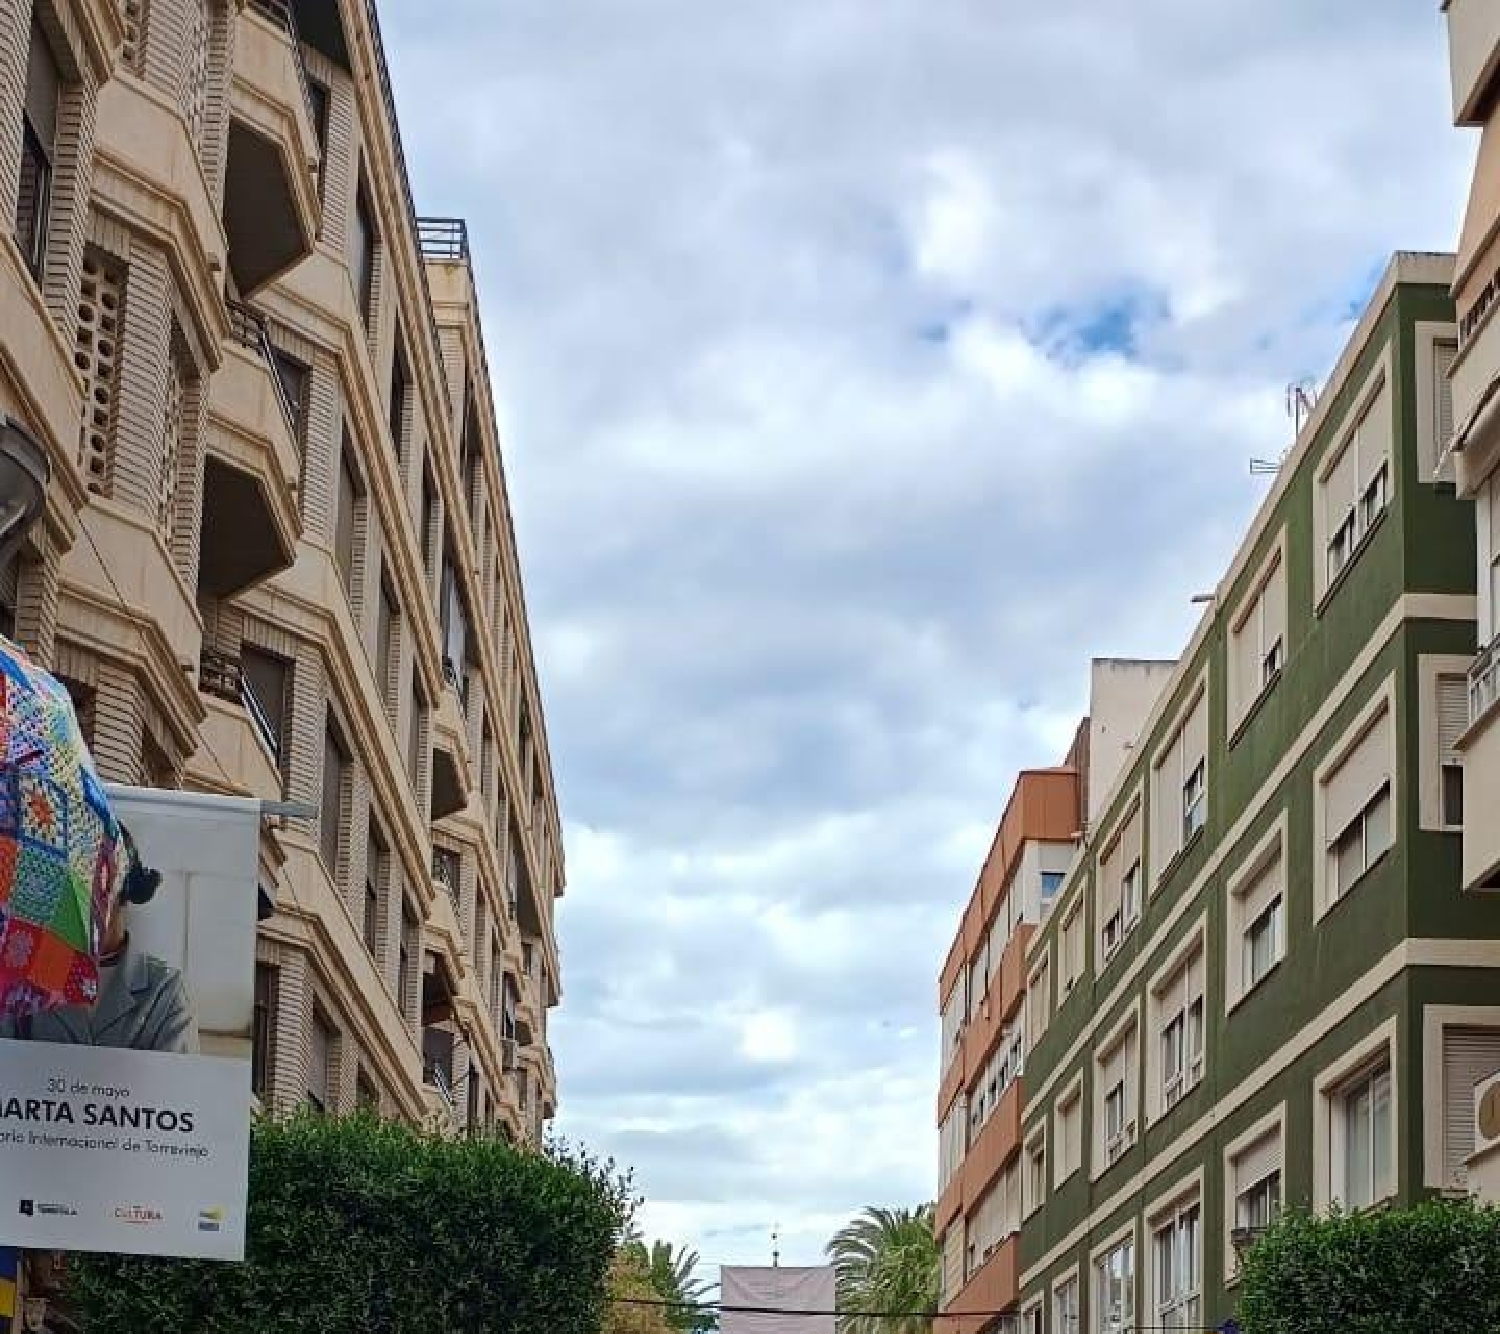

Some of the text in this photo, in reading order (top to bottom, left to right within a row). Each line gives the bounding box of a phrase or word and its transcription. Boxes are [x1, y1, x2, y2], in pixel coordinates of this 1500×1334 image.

[48, 1078, 130, 1099] 30 de mayo
[0, 1097, 194, 1132] ARTA SANTOS
[123, 1138, 141, 1151] de
